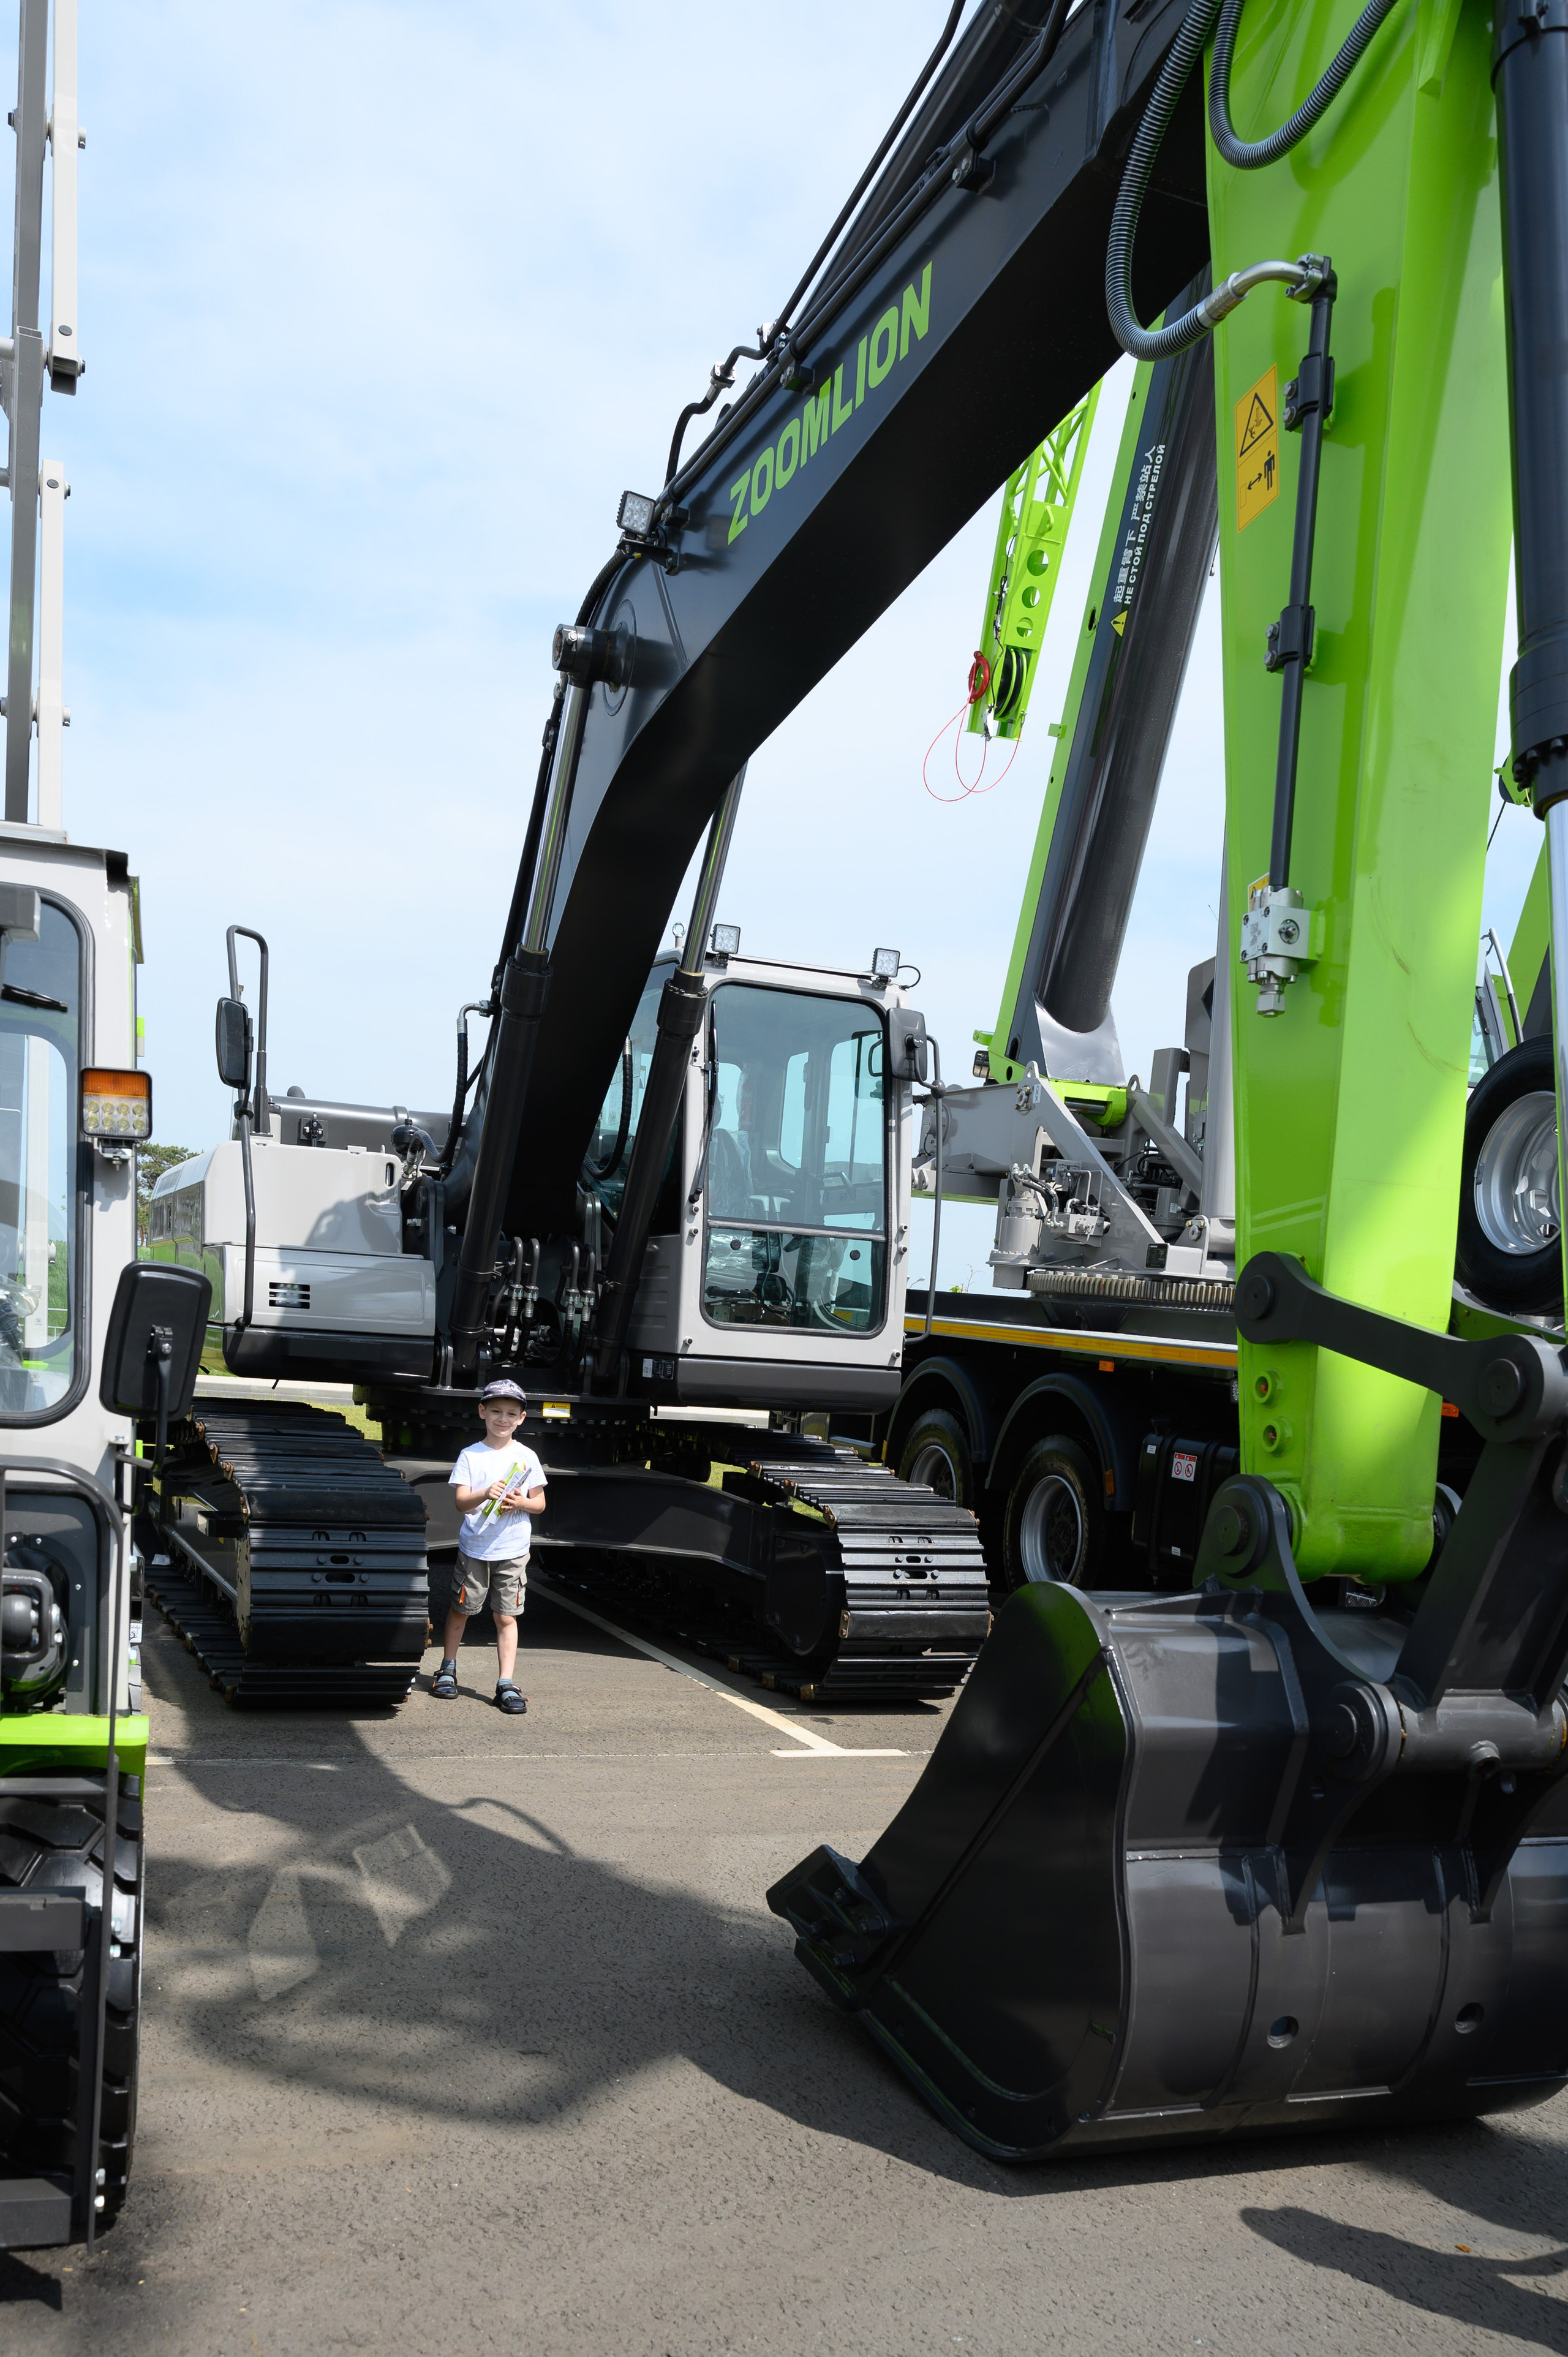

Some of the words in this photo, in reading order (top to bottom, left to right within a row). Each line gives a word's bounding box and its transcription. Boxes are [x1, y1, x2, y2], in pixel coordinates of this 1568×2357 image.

[728, 260, 933, 546] ZOOMLION
[1114, 529, 1136, 603] 起重臂下
[1131, 445, 1156, 521] 严禁站人
[1123, 586, 1134, 605] НЕ
[1129, 546, 1143, 584] СТОЙ
[1137, 513, 1152, 543] ПОД
[1145, 444, 1166, 510] СТРЕЛОЙ
